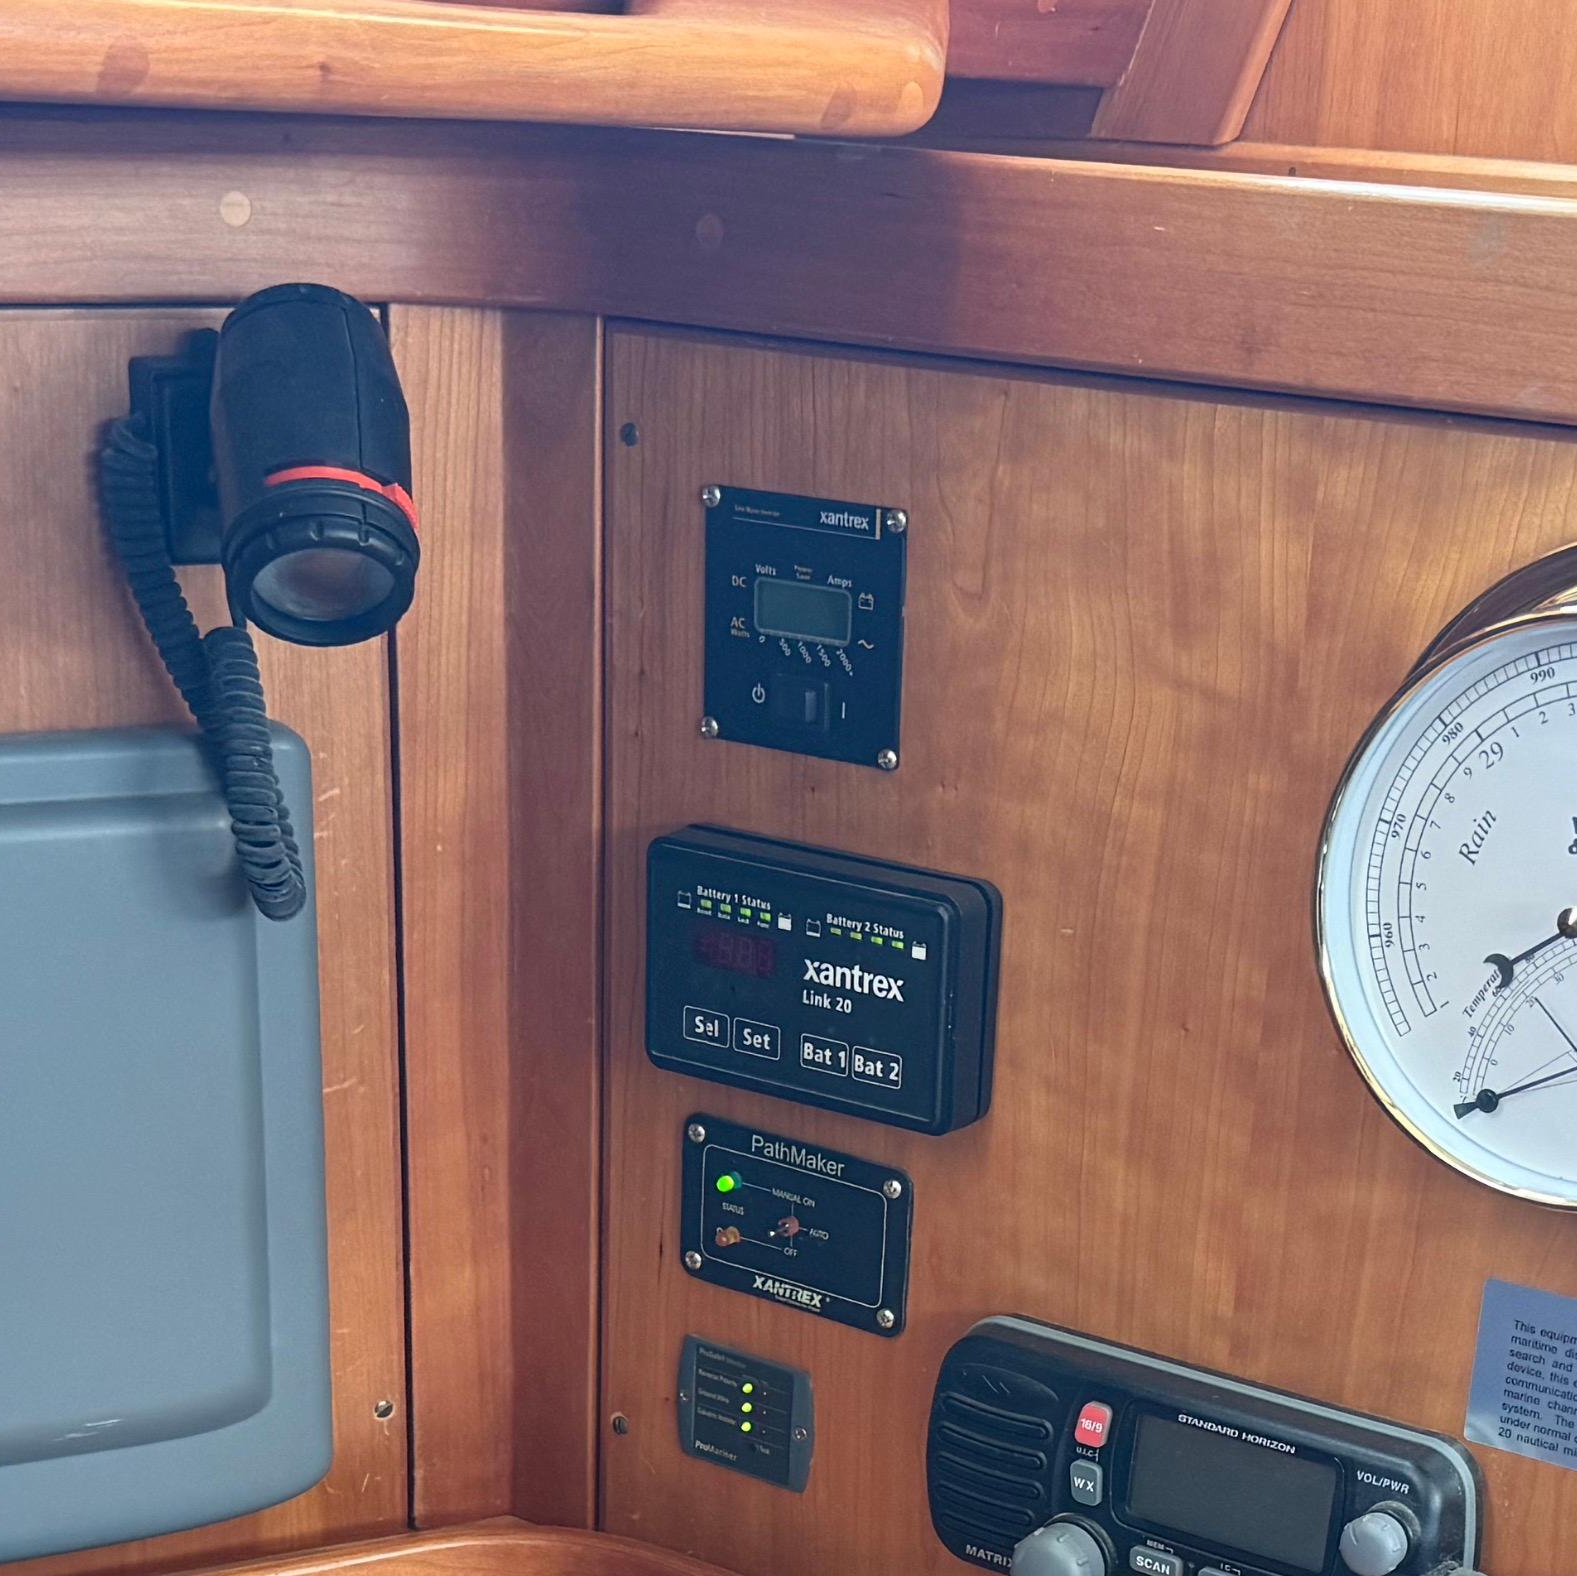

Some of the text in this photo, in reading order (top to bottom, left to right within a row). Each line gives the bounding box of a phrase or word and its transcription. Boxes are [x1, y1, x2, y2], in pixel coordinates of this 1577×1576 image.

[820, 511, 869, 530] xantrex
[732, 576, 746, 588] DC
[756, 564, 852, 588] Volts Amps
[731, 617, 745, 629] AC
[797, 641, 812, 663] 1000
[817, 645, 830, 667] 1500
[1530, 667, 1555, 685] 990
[1442, 722, 1464, 745] 980
[1479, 742, 1504, 769] 29
[1392, 813, 1407, 839] 970
[1459, 810, 1497, 865] Rain
[697, 886, 771, 910] Battery 1 Status
[826, 913, 904, 939] Battery 2 Status
[1383, 922, 1393, 948] 960
[803, 959, 904, 1002] xantrex
[803, 989, 852, 1014] Link 20
[695, 1015, 719, 1039] Sel
[743, 1028, 770, 1051] Set
[803, 1043, 846, 1068] Bat 1
[855, 1055, 899, 1080] Bat 2
[752, 1134, 845, 1177] PathMaker
[772, 1188, 801, 1204] MANUAL
[722, 1202, 744, 1215] STATUS
[784, 1247, 798, 1256] OFF
[753, 1275, 822, 1308] XANTREX
[1515, 1320, 1535, 1334] This
[1511, 1335, 1558, 1354] maritime
[1509, 1348, 1546, 1365] search
[1552, 1360, 1573, 1372] and
[1550, 1372, 1569, 1385] this
[1504, 1389, 1540, 1405] marine
[1081, 1418, 1103, 1434] 16/9
[1500, 1415, 1531, 1430] under
[1534, 1425, 1571, 1441] normal
[1555, 1415, 1574, 1428] The
[1177, 1414, 1296, 1454] STANDARD HORIZON
[1498, 1427, 1512, 1439] 20
[1516, 1433, 1559, 1452] nautical
[1356, 1470, 1410, 1495] VOL/PWR
[1136, 1555, 1170, 1575] SCAN
